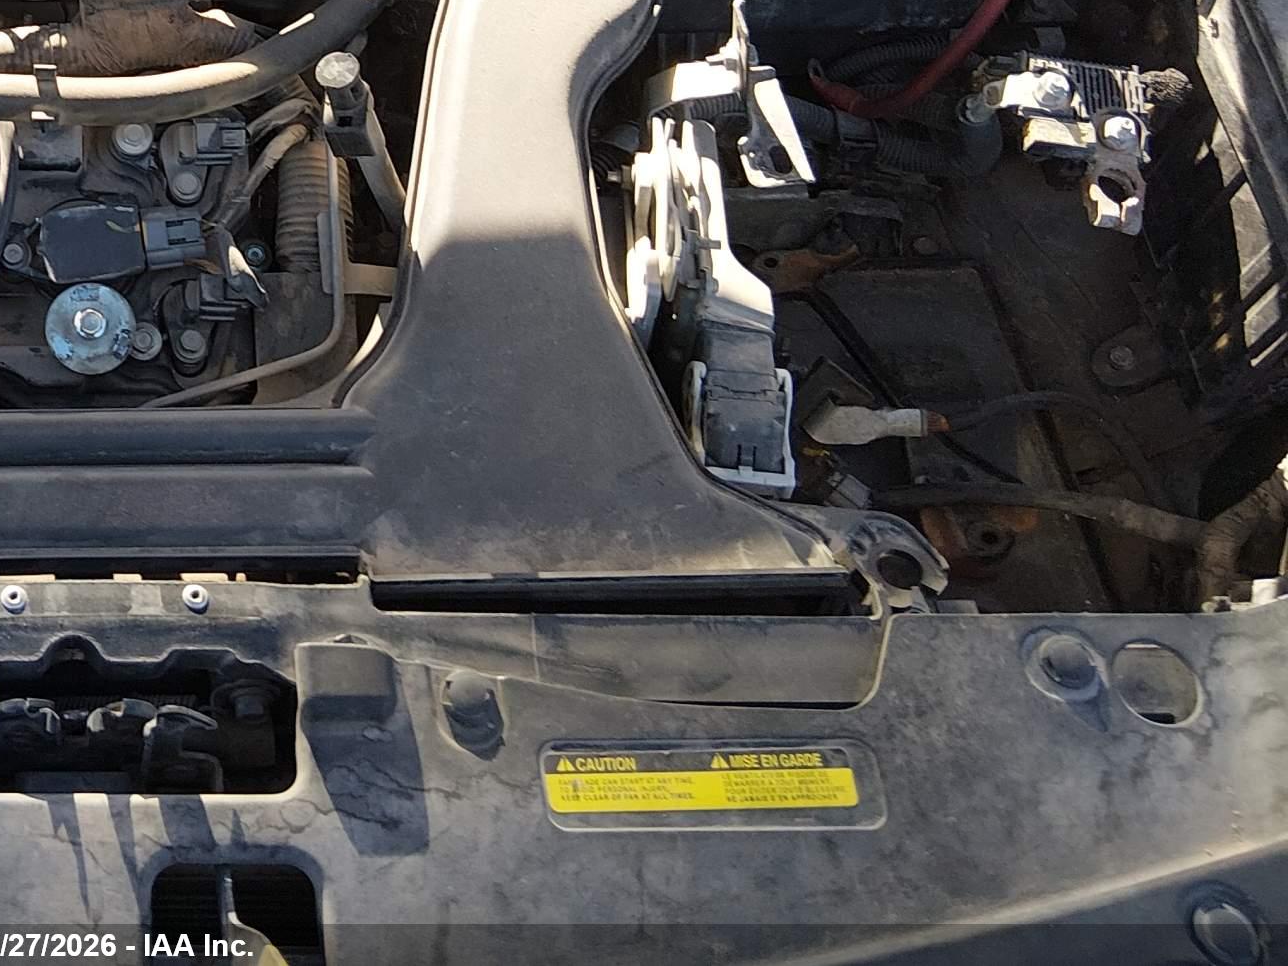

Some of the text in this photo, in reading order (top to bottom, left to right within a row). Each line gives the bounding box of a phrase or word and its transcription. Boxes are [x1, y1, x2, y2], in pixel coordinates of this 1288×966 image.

[575, 756, 637, 771] CAUTION
[728, 753, 823, 768] MISE EN GARDE
